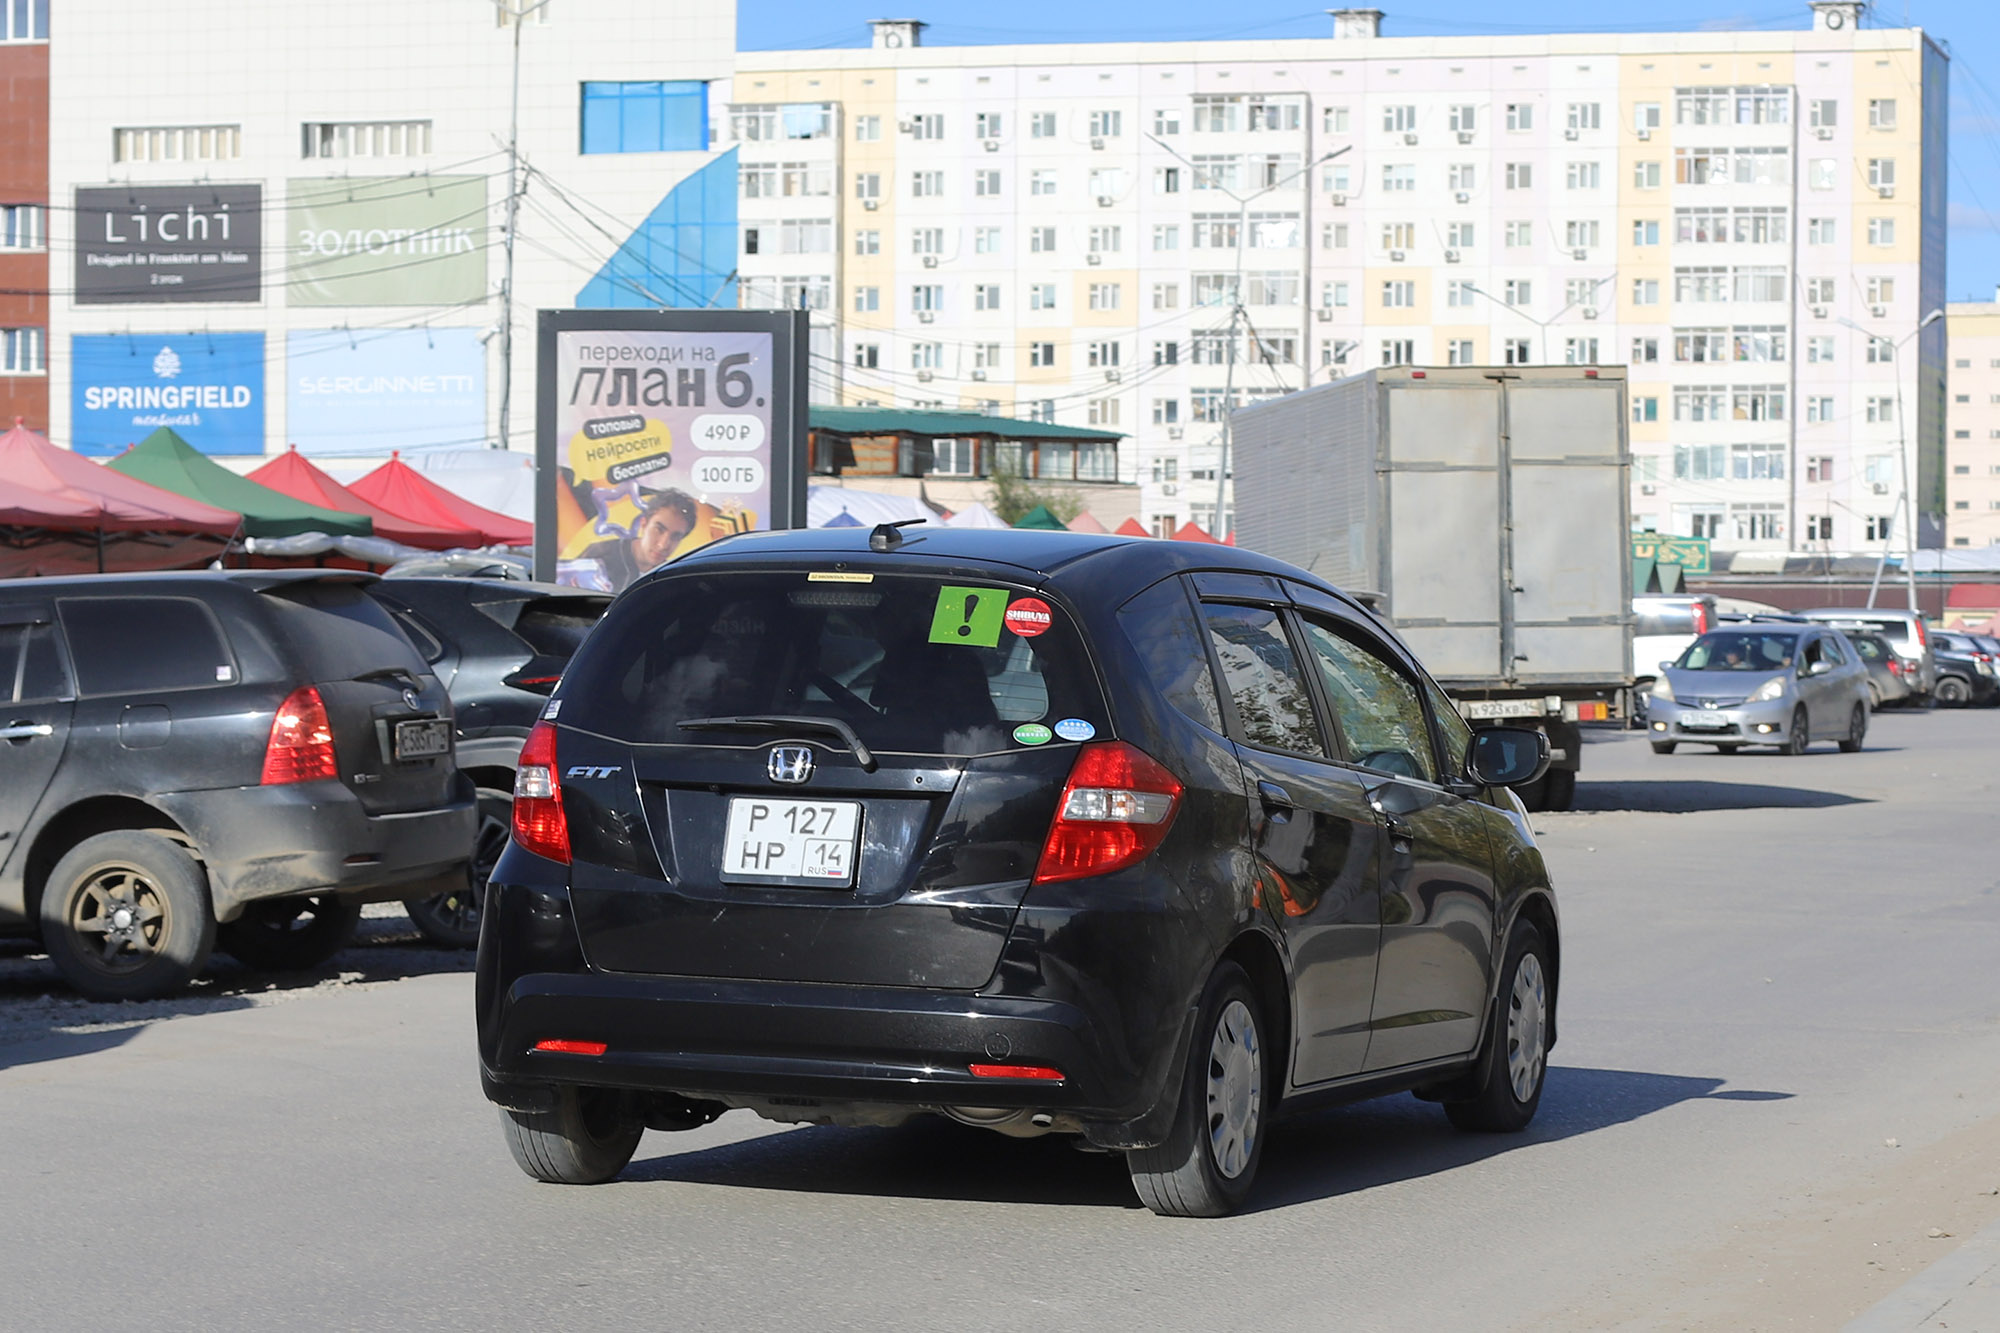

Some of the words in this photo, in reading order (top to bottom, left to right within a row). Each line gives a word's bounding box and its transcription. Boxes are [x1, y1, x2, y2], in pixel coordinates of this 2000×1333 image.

[105, 203, 230, 243] Lichi
[298, 228, 475, 256] ЗОЛОТНИК
[86, 252, 133, 268] Designed
[135, 253, 147, 265] in
[149, 253, 198, 265] Frankfurt
[201, 253, 218, 264] am
[220, 251, 248, 264] Main
[579, 345, 684, 366] переходи
[691, 345, 716, 361] на
[299, 374, 474, 395] SERGINNETTI
[84, 385, 251, 410] SPRINGFIELD
[590, 418, 641, 435] топовые
[704, 424, 737, 441] 490
[586, 436, 662, 462] нейросети
[612, 456, 669, 481] бесплатно
[701, 467, 732, 482] 100
[735, 467, 754, 482] ГБ
[1006, 609, 1051, 622] SHIBUYA
[565, 766, 622, 779] FIT
[783, 805, 837, 836] 127
[814, 843, 842, 867] 14
[807, 866, 827, 875] RUS
